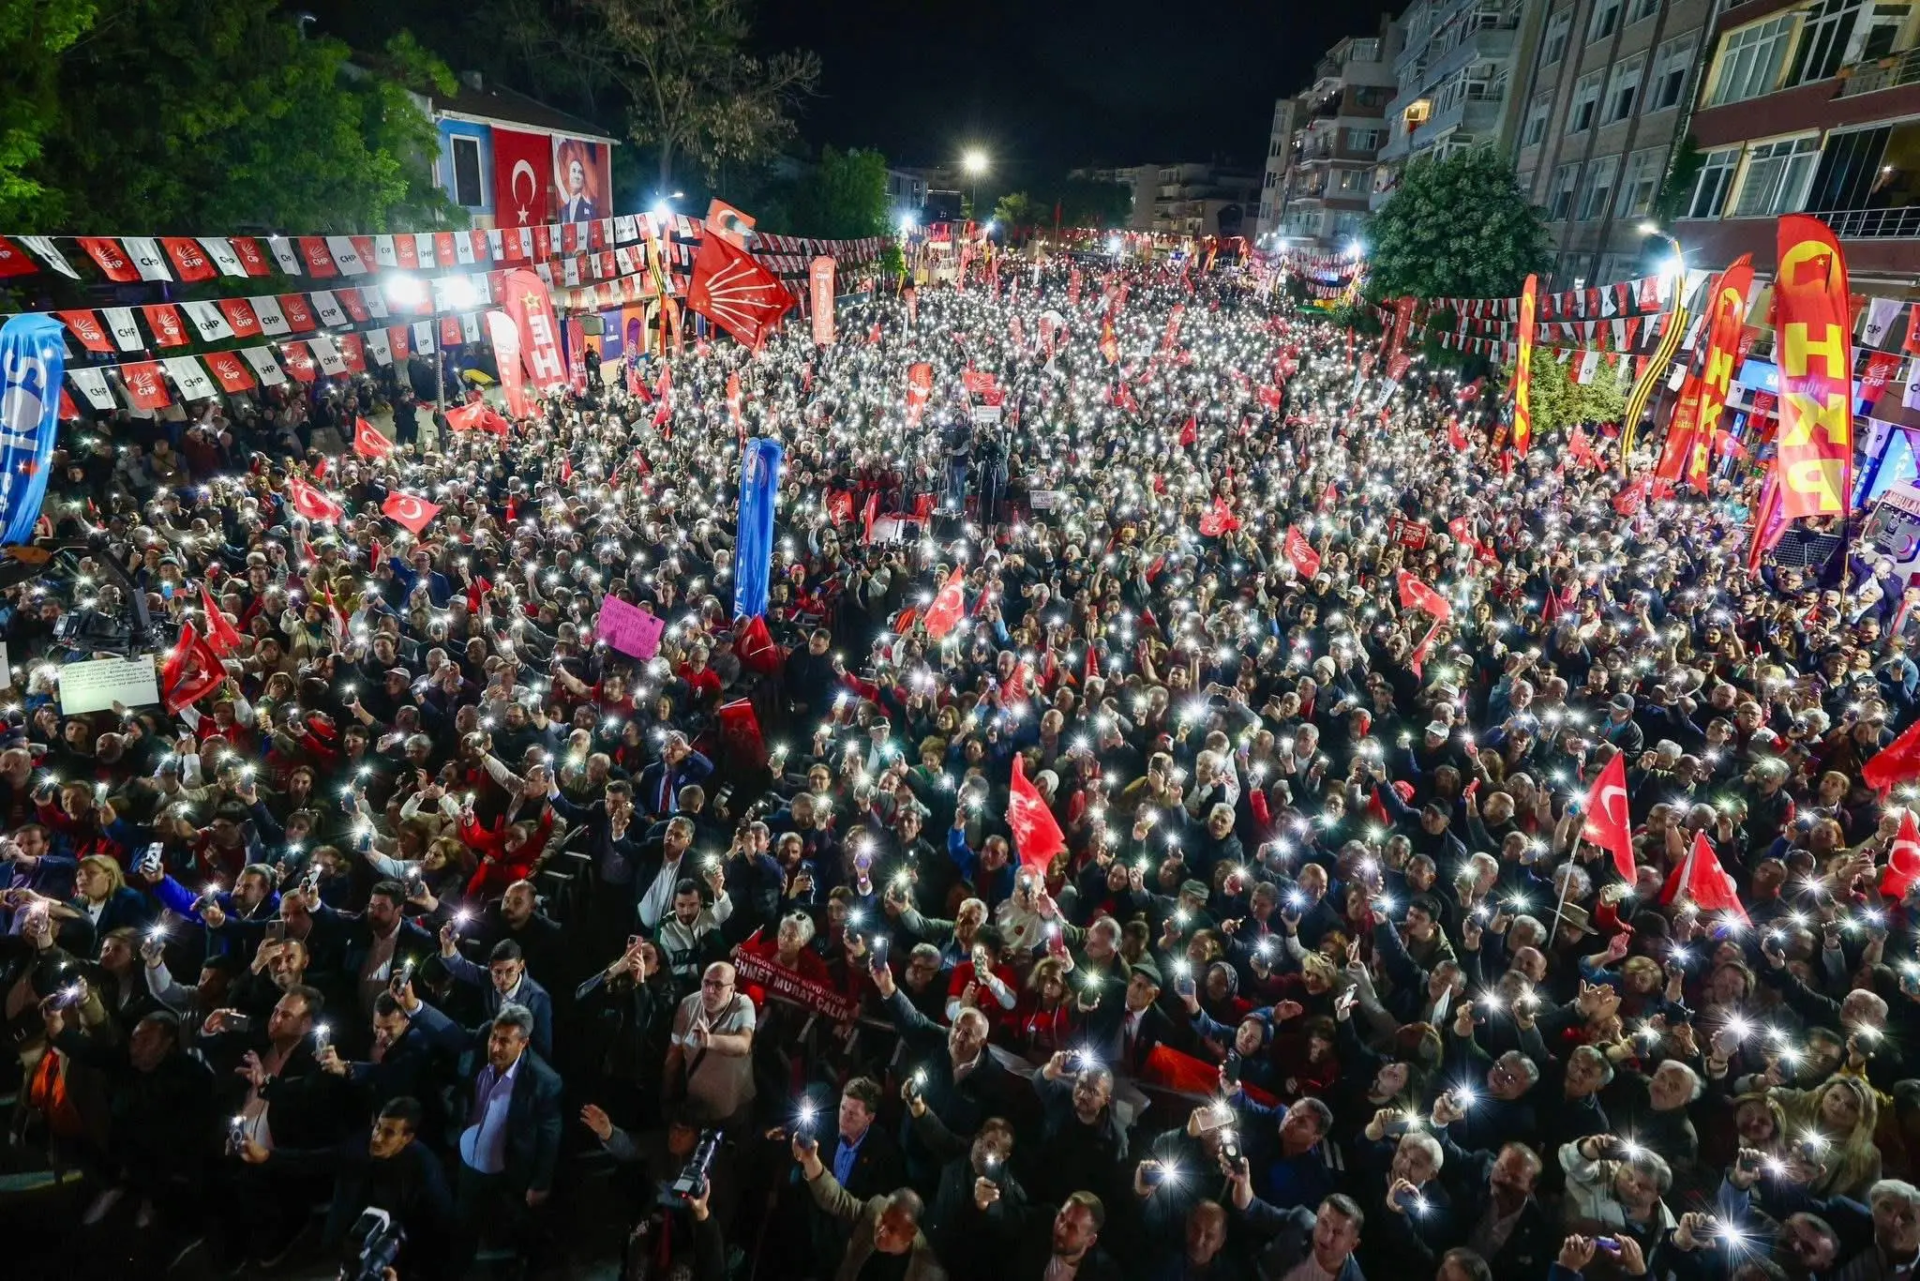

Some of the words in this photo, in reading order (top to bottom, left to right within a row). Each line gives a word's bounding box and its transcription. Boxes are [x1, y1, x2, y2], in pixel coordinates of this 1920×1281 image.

[183, 258, 203, 268] CHP
[312, 257, 329, 266] CHP
[340, 254, 356, 263] CHP
[103, 260, 124, 269] CHP
[293, 314, 307, 322] CHP
[321, 308, 337, 318] CHP
[200, 320, 220, 331] CHP
[236, 318, 253, 327] CHP
[262, 316, 280, 325] CHP
[118, 327, 136, 338] CHP
[224, 371, 240, 379] CHP
[184, 377, 203, 387] CHP
[1862, 376, 1885, 387] CHP
[90, 387, 107, 397] CHP
[137, 386, 156, 396] CHP
[734, 957, 773, 984] EHMET
[774, 976, 815, 1003] MURAT
